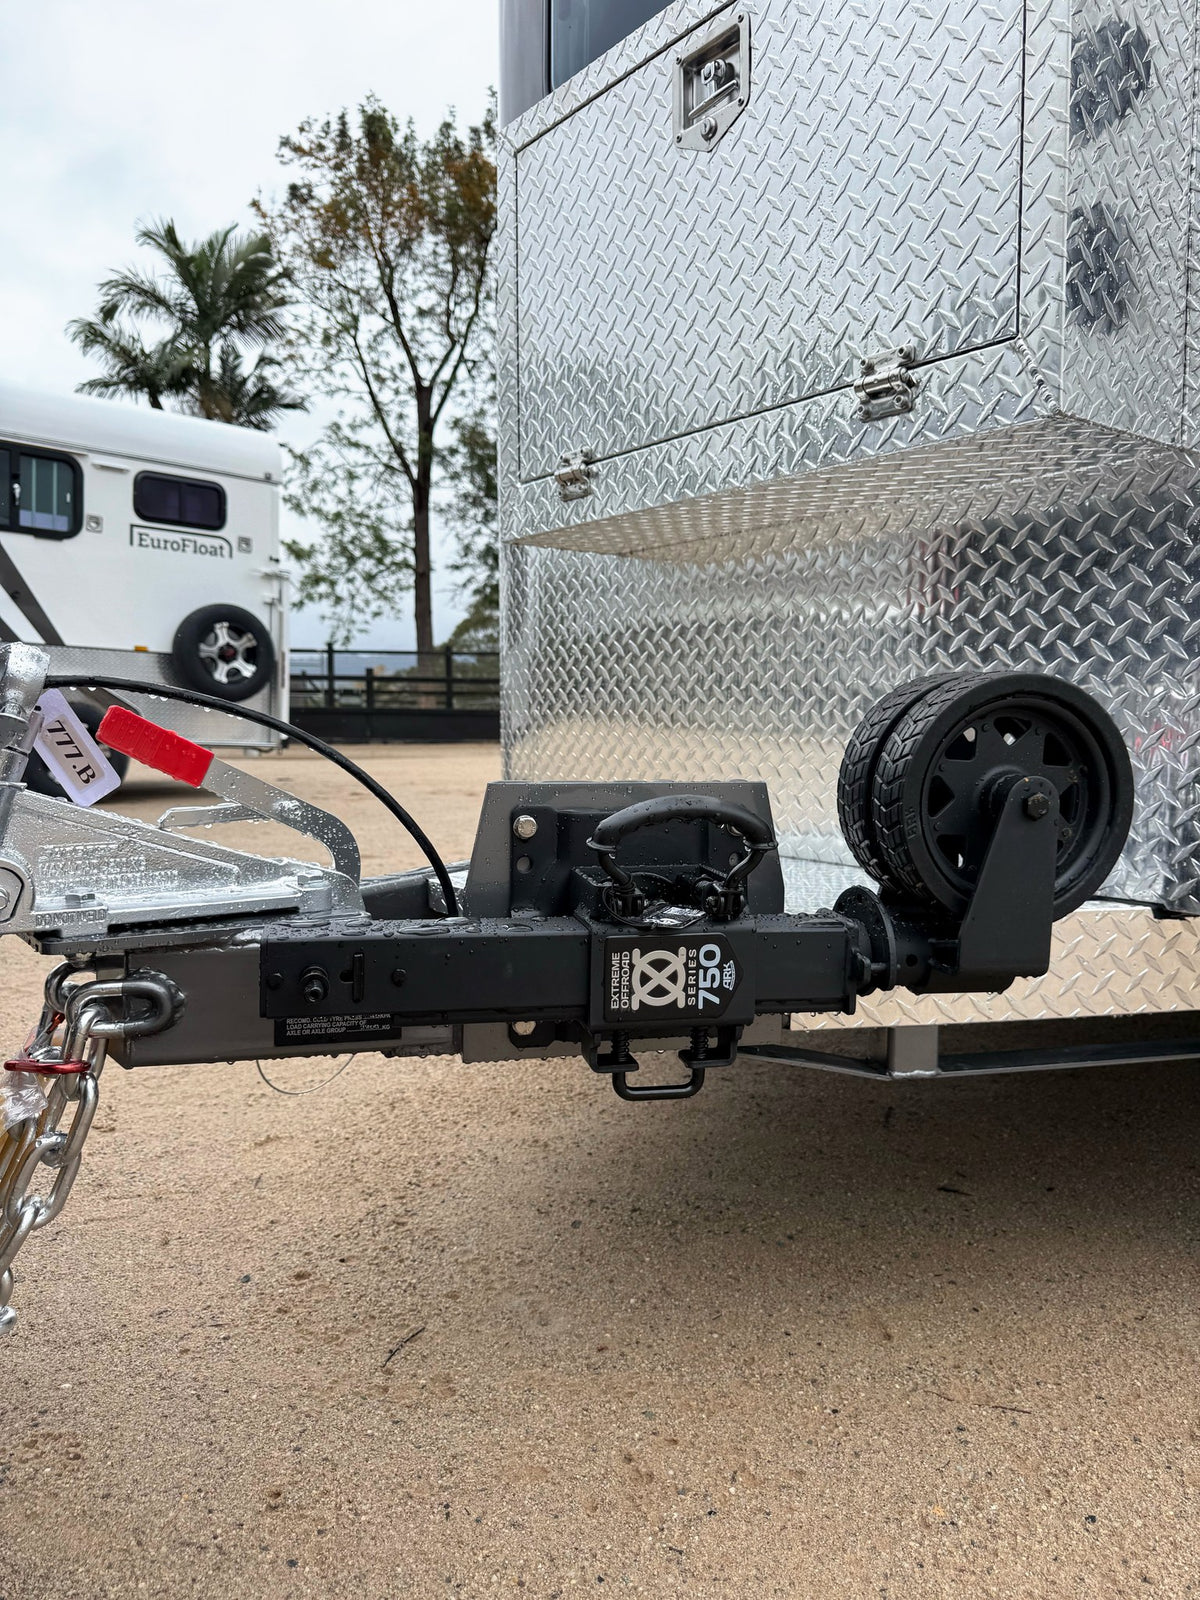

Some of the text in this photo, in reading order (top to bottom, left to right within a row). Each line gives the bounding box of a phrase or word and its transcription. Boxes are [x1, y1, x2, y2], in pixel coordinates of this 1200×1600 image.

[137, 532, 225, 558] EuroFloat
[46, 719, 97, 785] 777.B
[611, 952, 621, 1009] EXTREME
[621, 951, 630, 1008] OFFROAD
[687, 948, 697, 1006] SERIES
[698, 943, 721, 1010] 750
[722, 962, 732, 988] ARK
[332, 1020, 359, 1028] CAPACITY
